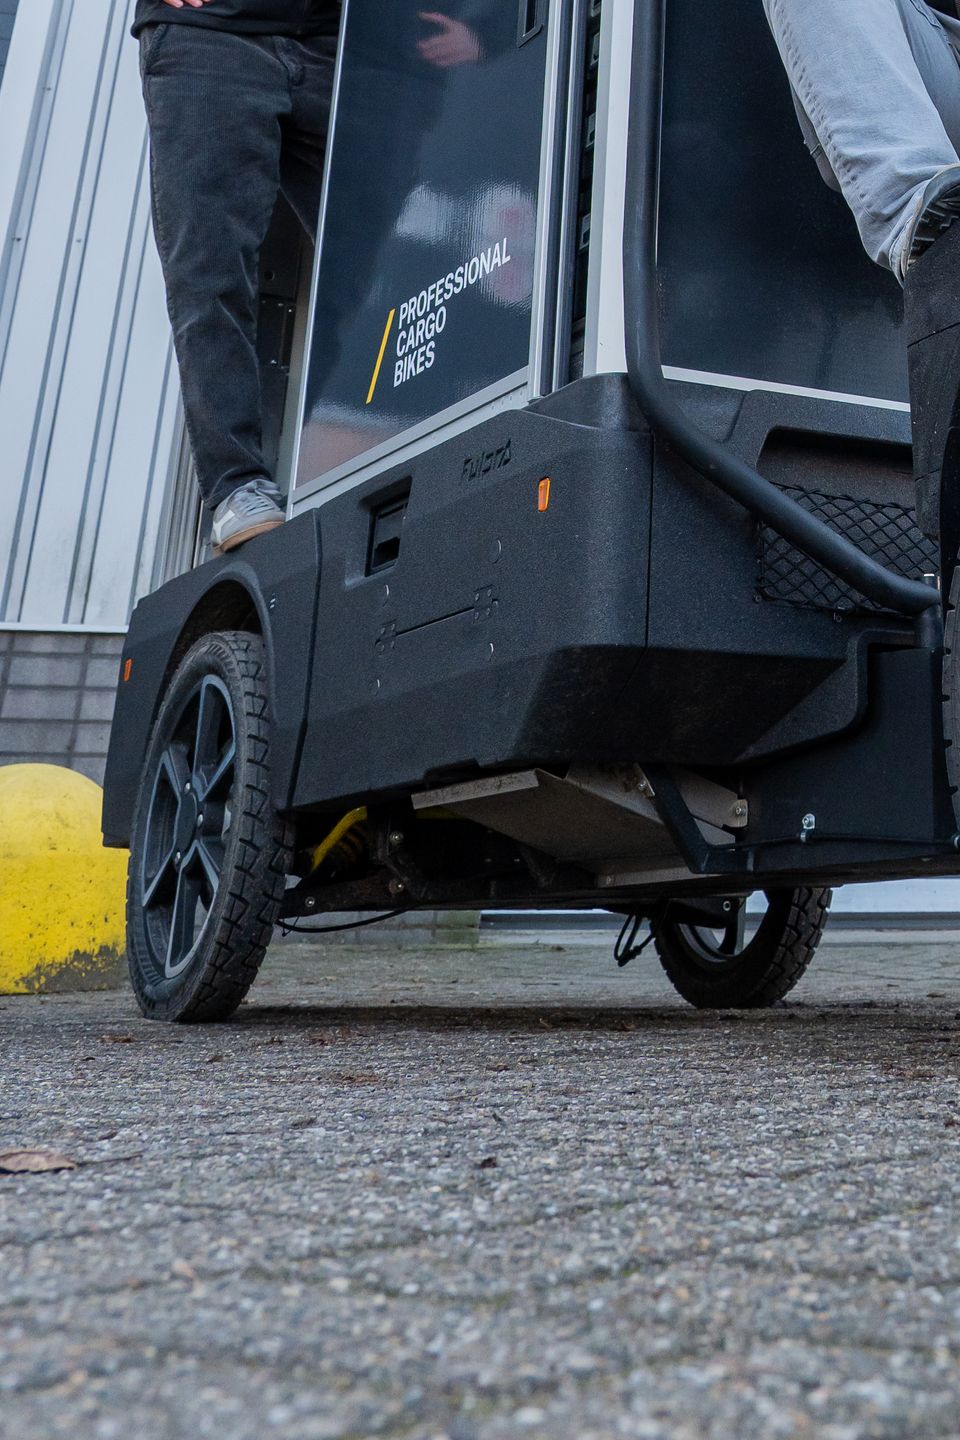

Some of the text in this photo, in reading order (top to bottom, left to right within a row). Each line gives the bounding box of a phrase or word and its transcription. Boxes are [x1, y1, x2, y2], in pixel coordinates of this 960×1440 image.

[399, 237, 511, 329] PROFESSIONAL
[396, 306, 446, 357] CARGO
[393, 340, 436, 388] BIKES
